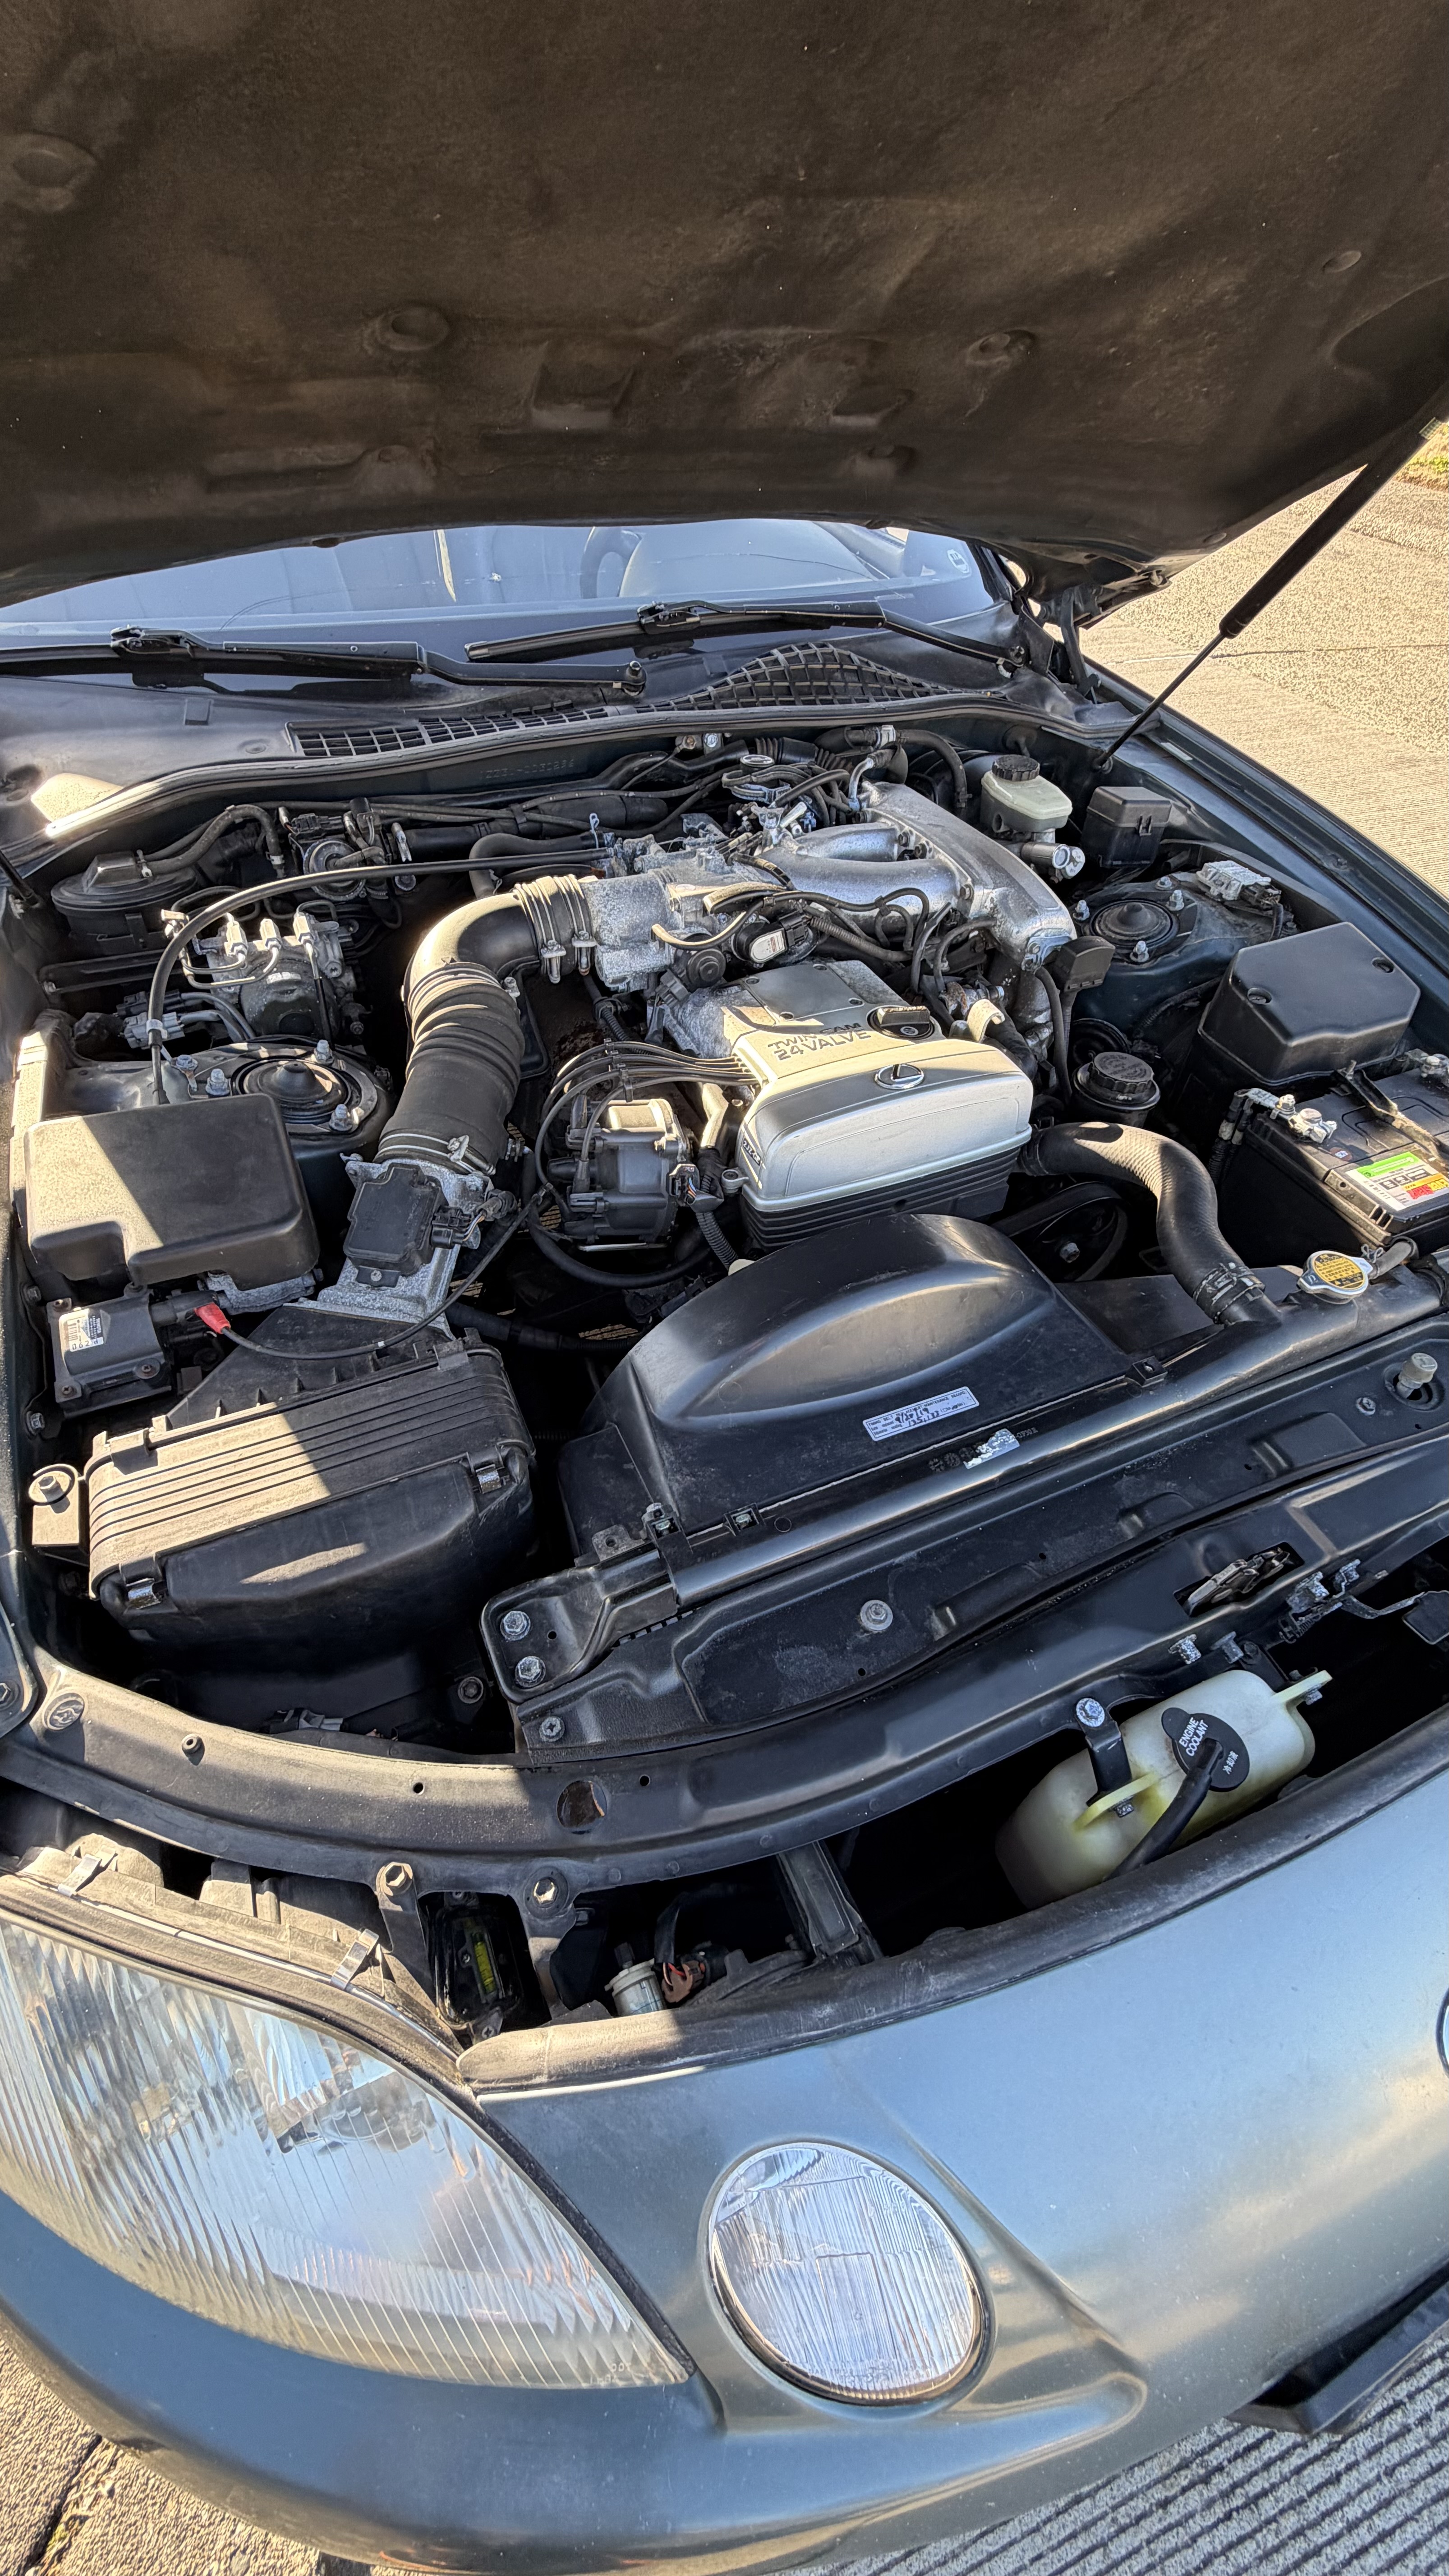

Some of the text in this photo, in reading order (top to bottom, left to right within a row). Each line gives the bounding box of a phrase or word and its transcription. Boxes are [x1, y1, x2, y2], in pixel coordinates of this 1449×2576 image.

[768, 1022, 862, 1049] TWIN CAM
[1178, 1717, 1199, 1748] ENGINE
[1186, 1720, 1209, 1757] COOLANT
